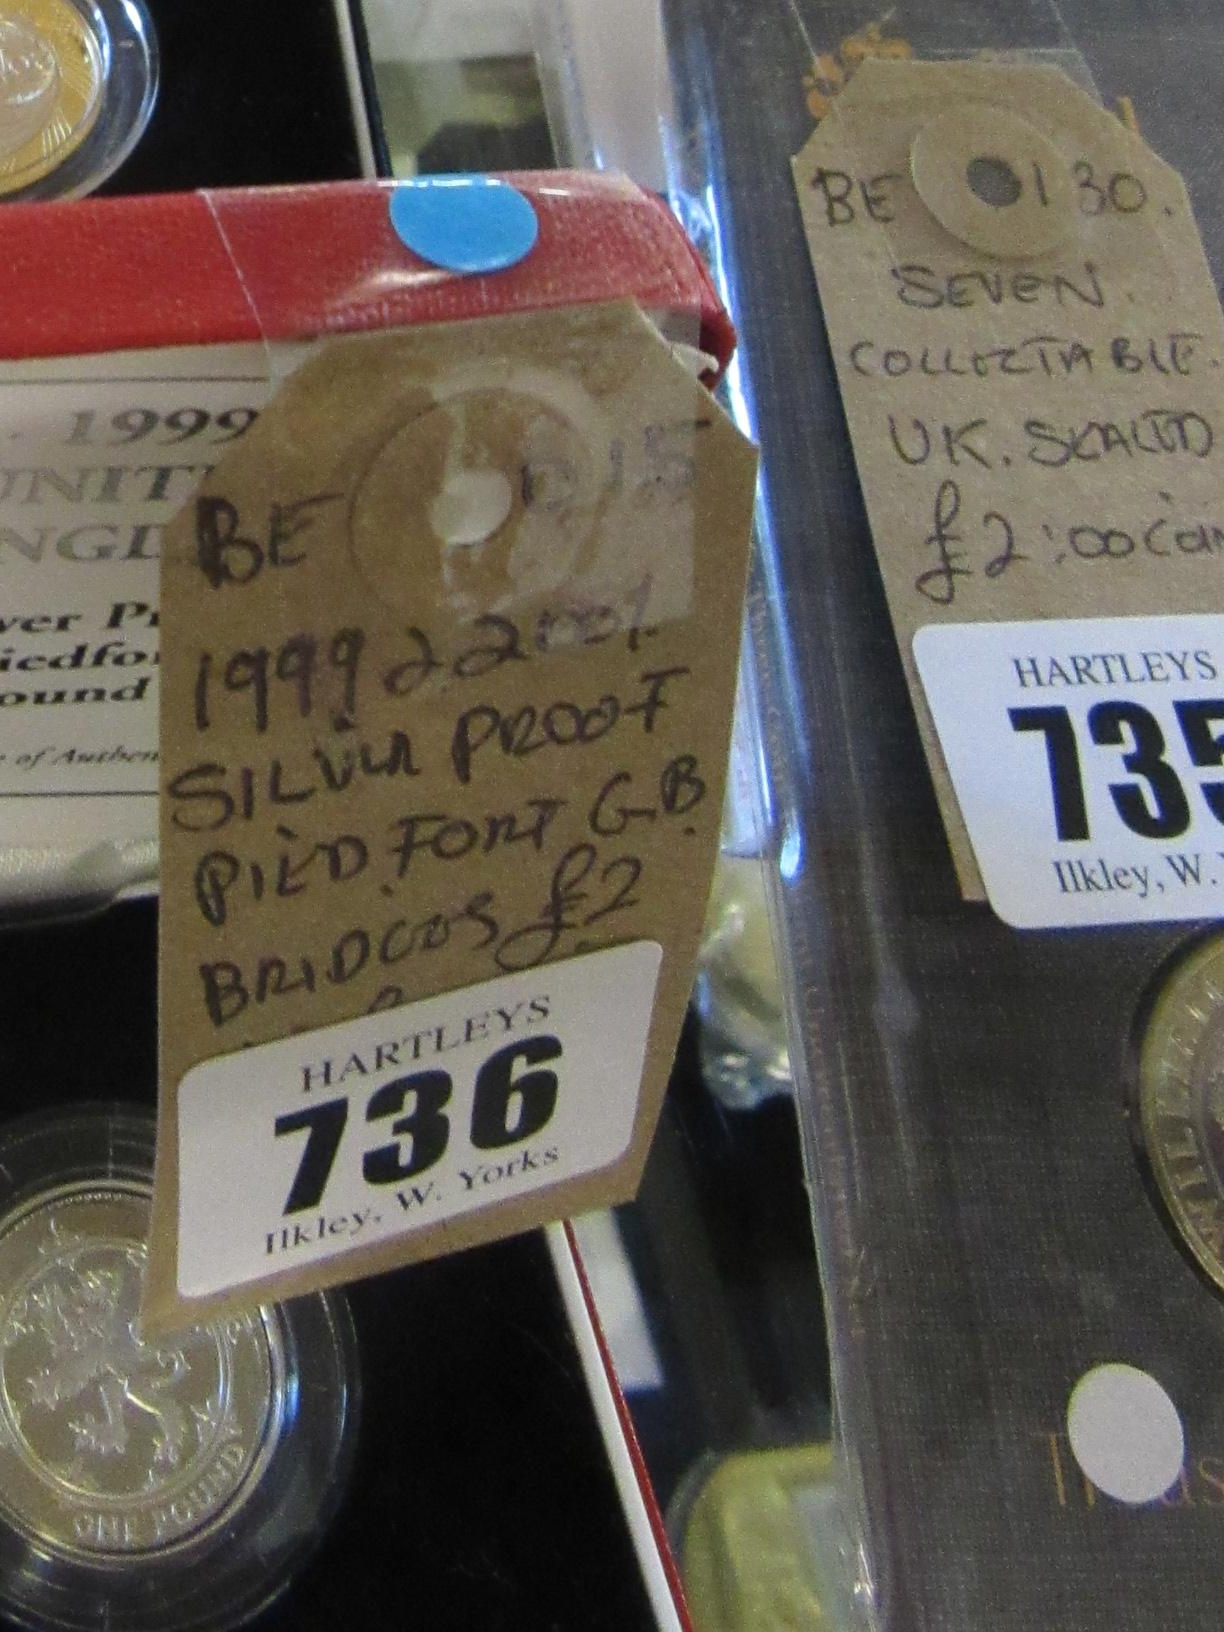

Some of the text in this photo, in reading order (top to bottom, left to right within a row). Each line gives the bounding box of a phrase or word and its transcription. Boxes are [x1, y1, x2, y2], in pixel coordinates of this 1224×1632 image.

[62, 407, 260, 447] 1999
[192, 491, 346, 590] BE
[1011, 648, 1219, 689] HARTLEYS
[13, 746, 51, 770] of
[1051, 851, 1218, 899] Ilkley, W.
[297, 993, 553, 1094] HARTLEYS
[271, 1033, 565, 1218] 736
[261, 1142, 562, 1258] Ilkley, W. Yorks
